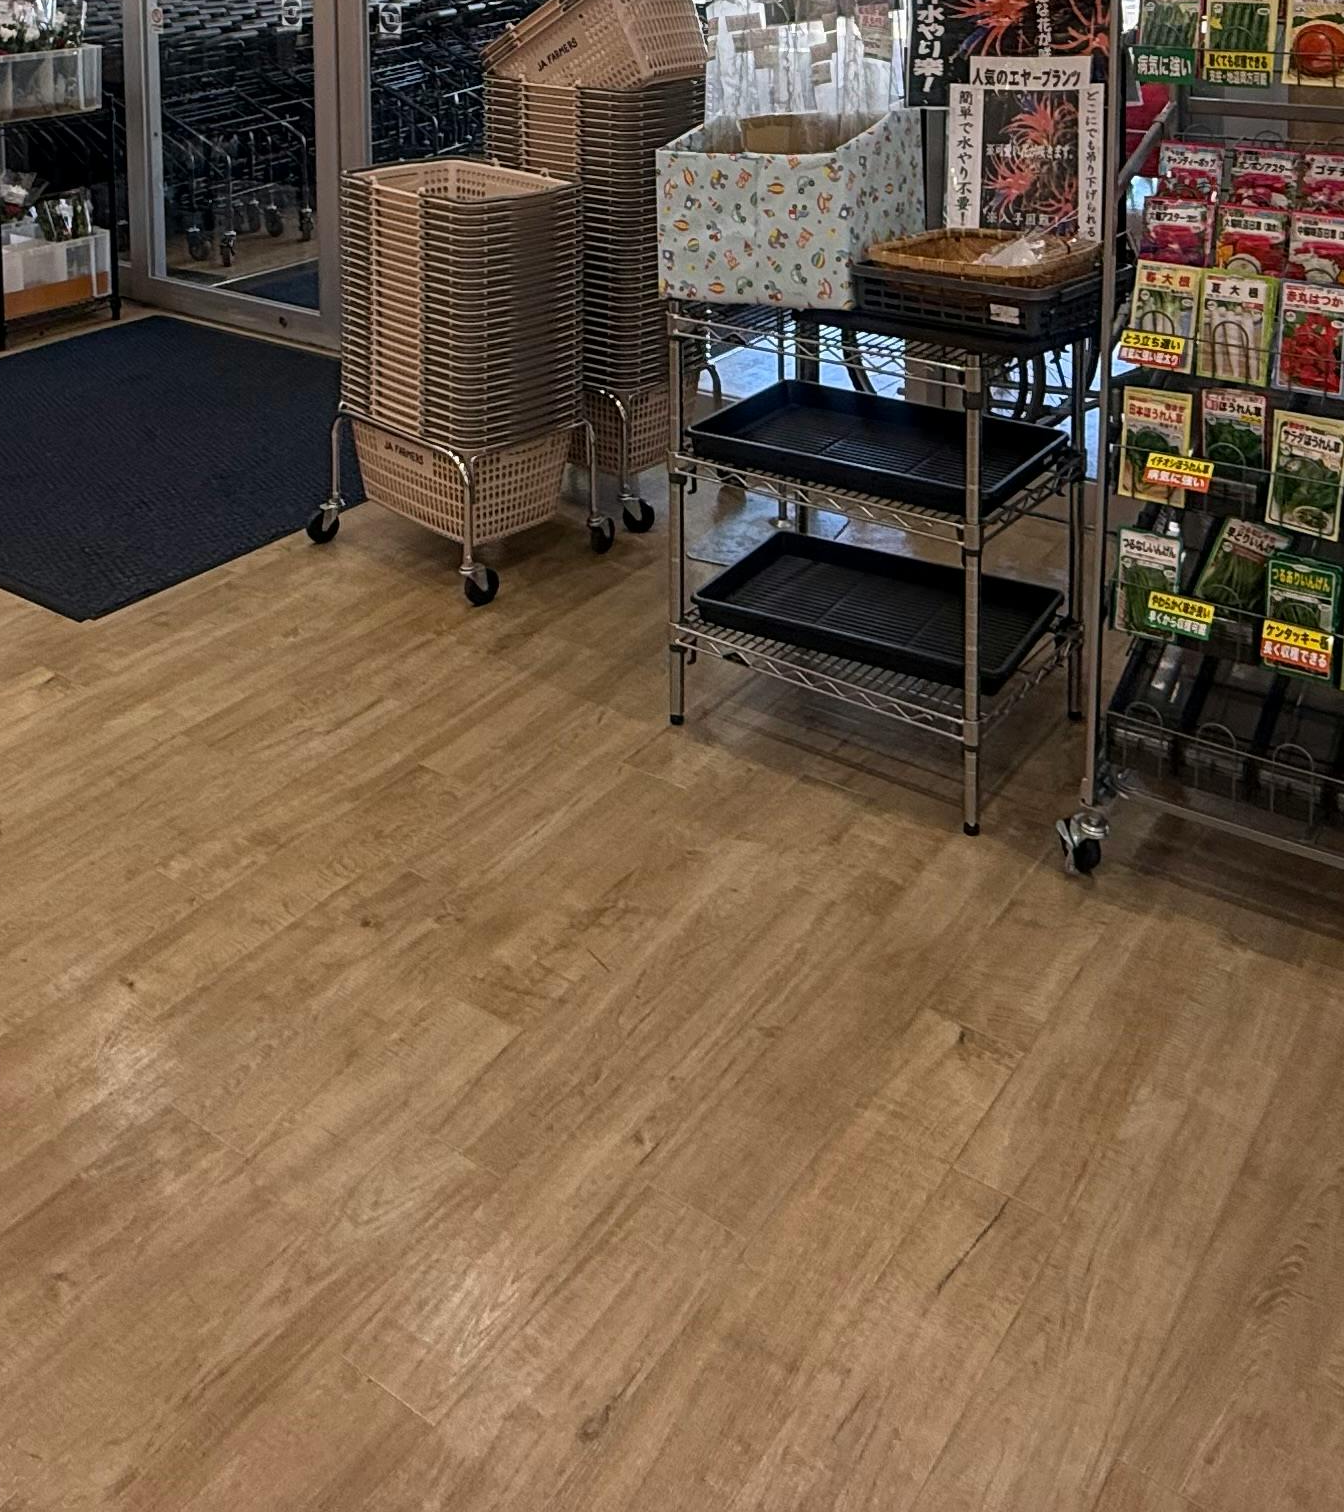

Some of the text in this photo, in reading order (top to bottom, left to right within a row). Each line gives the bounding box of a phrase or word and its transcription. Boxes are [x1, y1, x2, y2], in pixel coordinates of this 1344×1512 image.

[1137, 55, 1191, 77] 病気に強い
[972, 68, 1081, 87] 人気のエヤープランツ
[957, 91, 974, 226] 簡単で水やり不要!
